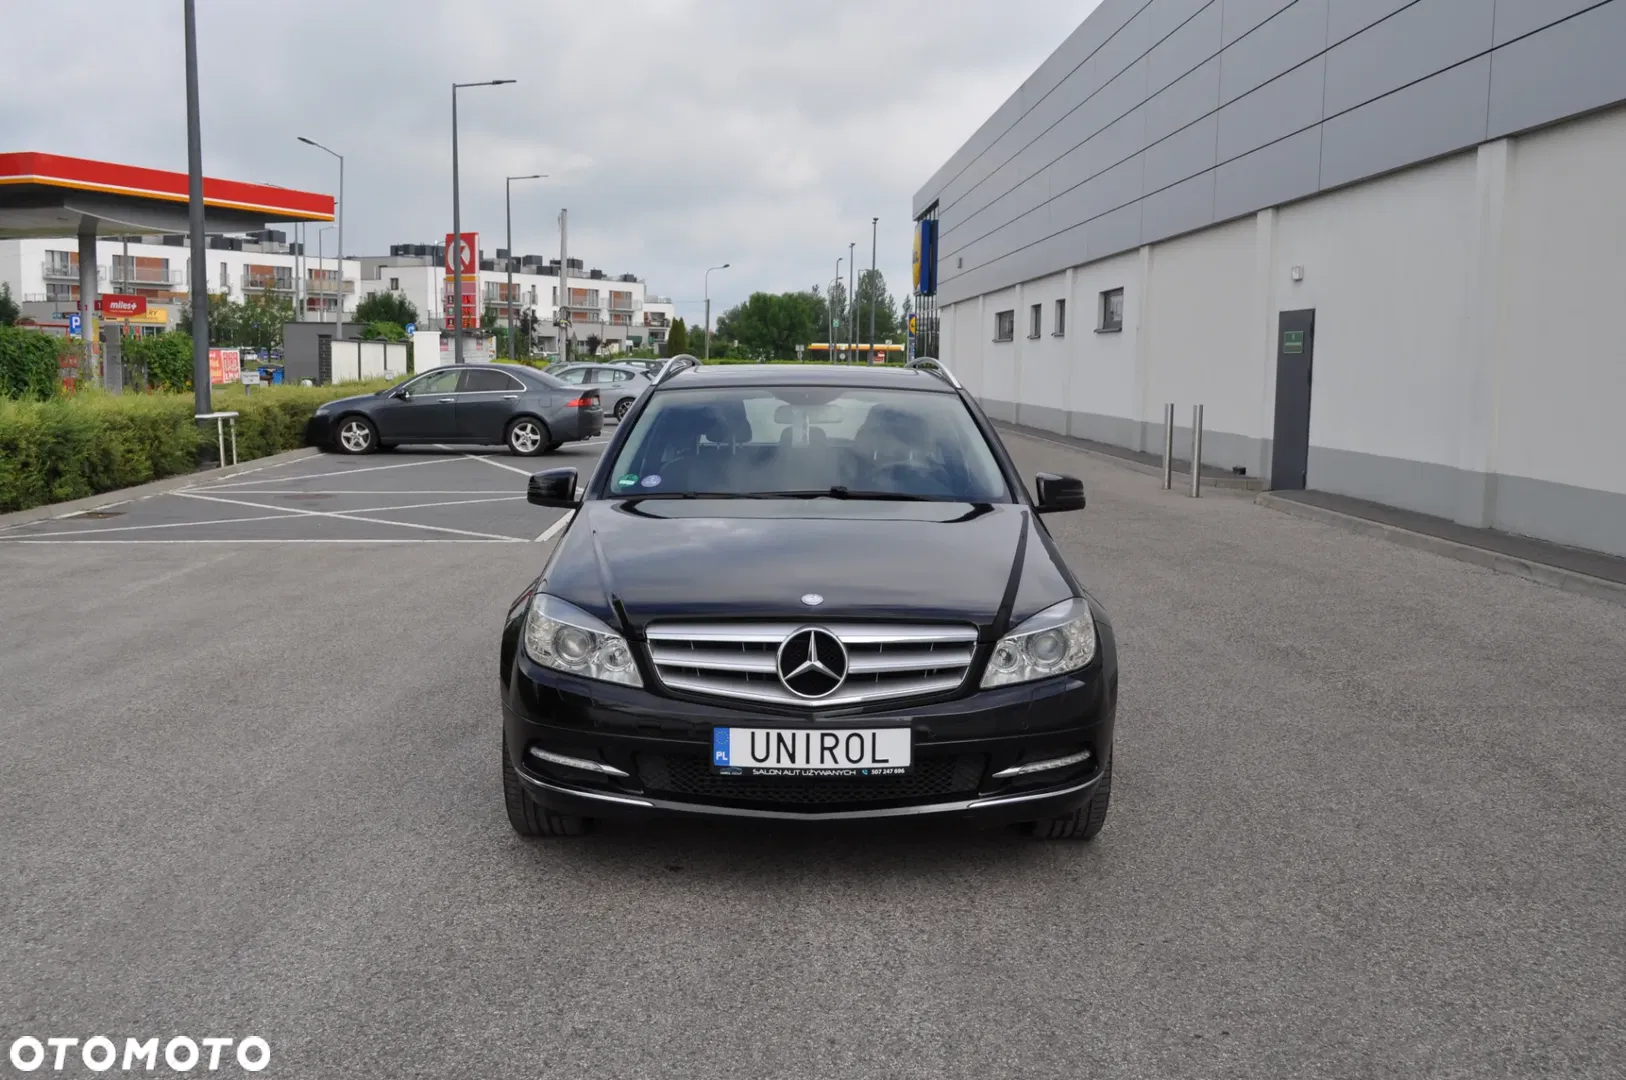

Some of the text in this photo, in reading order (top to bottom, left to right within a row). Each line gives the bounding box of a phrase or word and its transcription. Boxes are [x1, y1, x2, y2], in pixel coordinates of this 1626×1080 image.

[72, 316, 80, 328] P
[751, 731, 889, 764] UNIROL
[716, 751, 728, 760] PL
